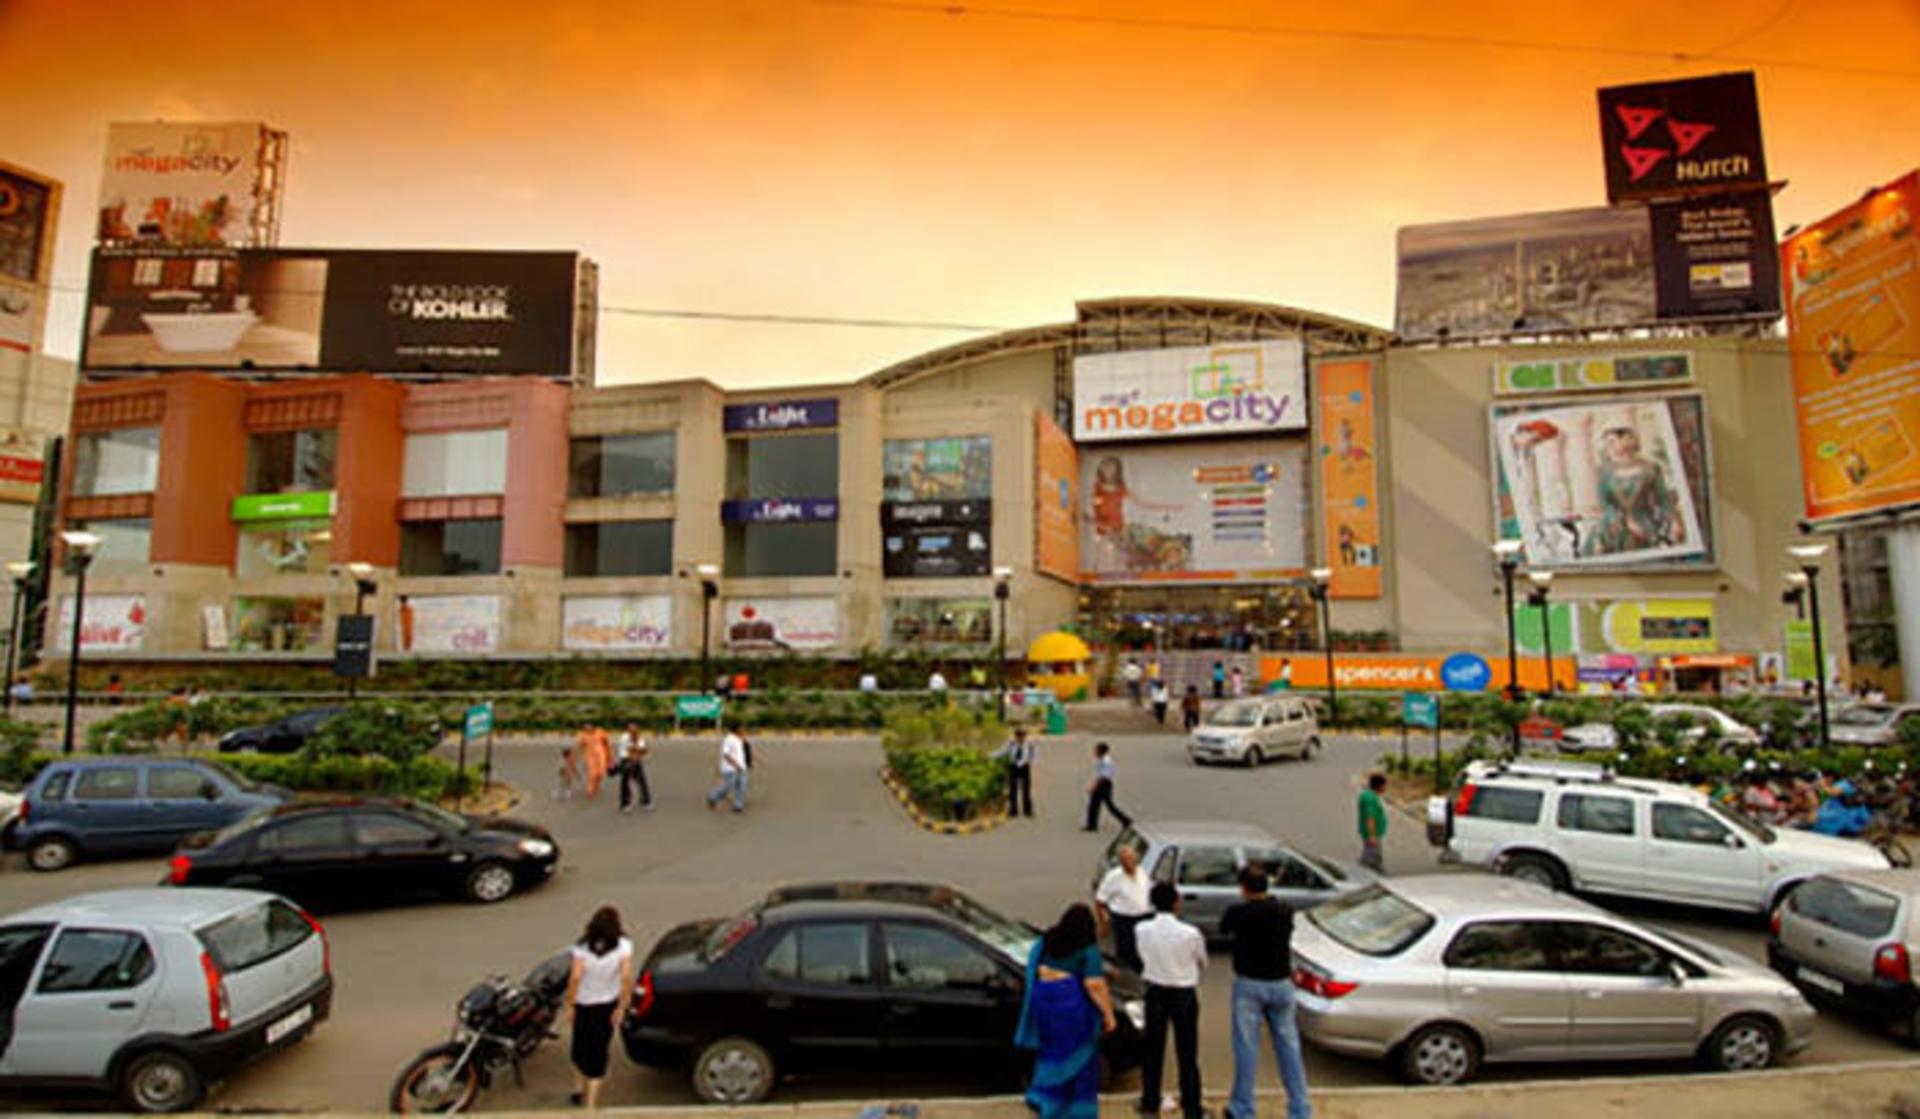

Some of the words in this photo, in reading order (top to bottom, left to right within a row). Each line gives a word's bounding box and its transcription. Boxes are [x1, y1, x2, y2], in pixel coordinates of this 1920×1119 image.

[115, 154, 241, 175] megacity
[1675, 155, 1749, 181] Hutch
[1084, 387, 1290, 432] megacity
